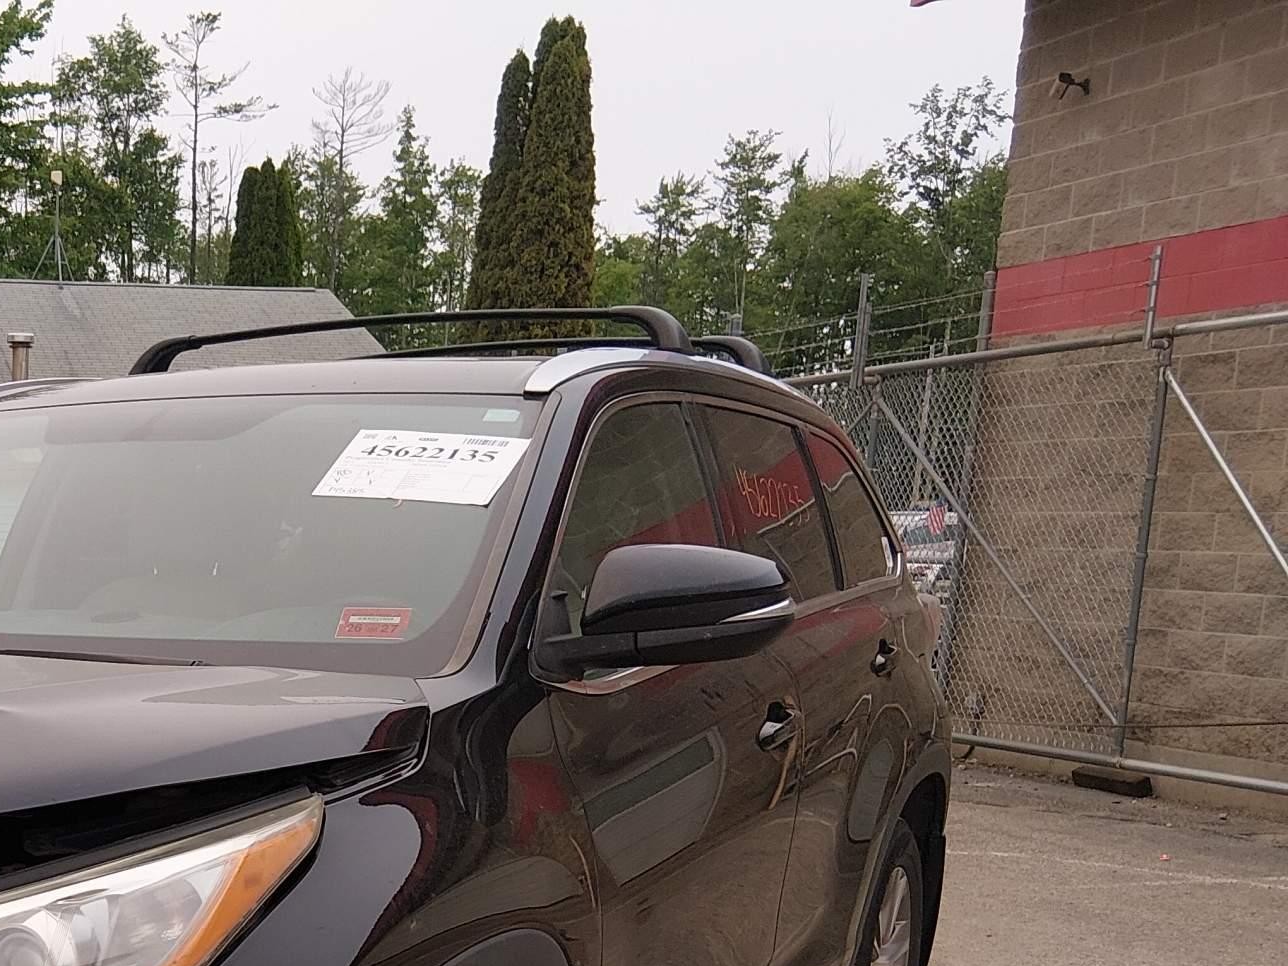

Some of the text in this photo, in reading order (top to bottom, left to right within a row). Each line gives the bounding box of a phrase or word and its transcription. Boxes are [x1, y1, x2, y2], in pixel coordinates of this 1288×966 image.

[361, 444, 500, 463] 45622135
[345, 623, 362, 633] 26
[380, 623, 400, 633] 27
